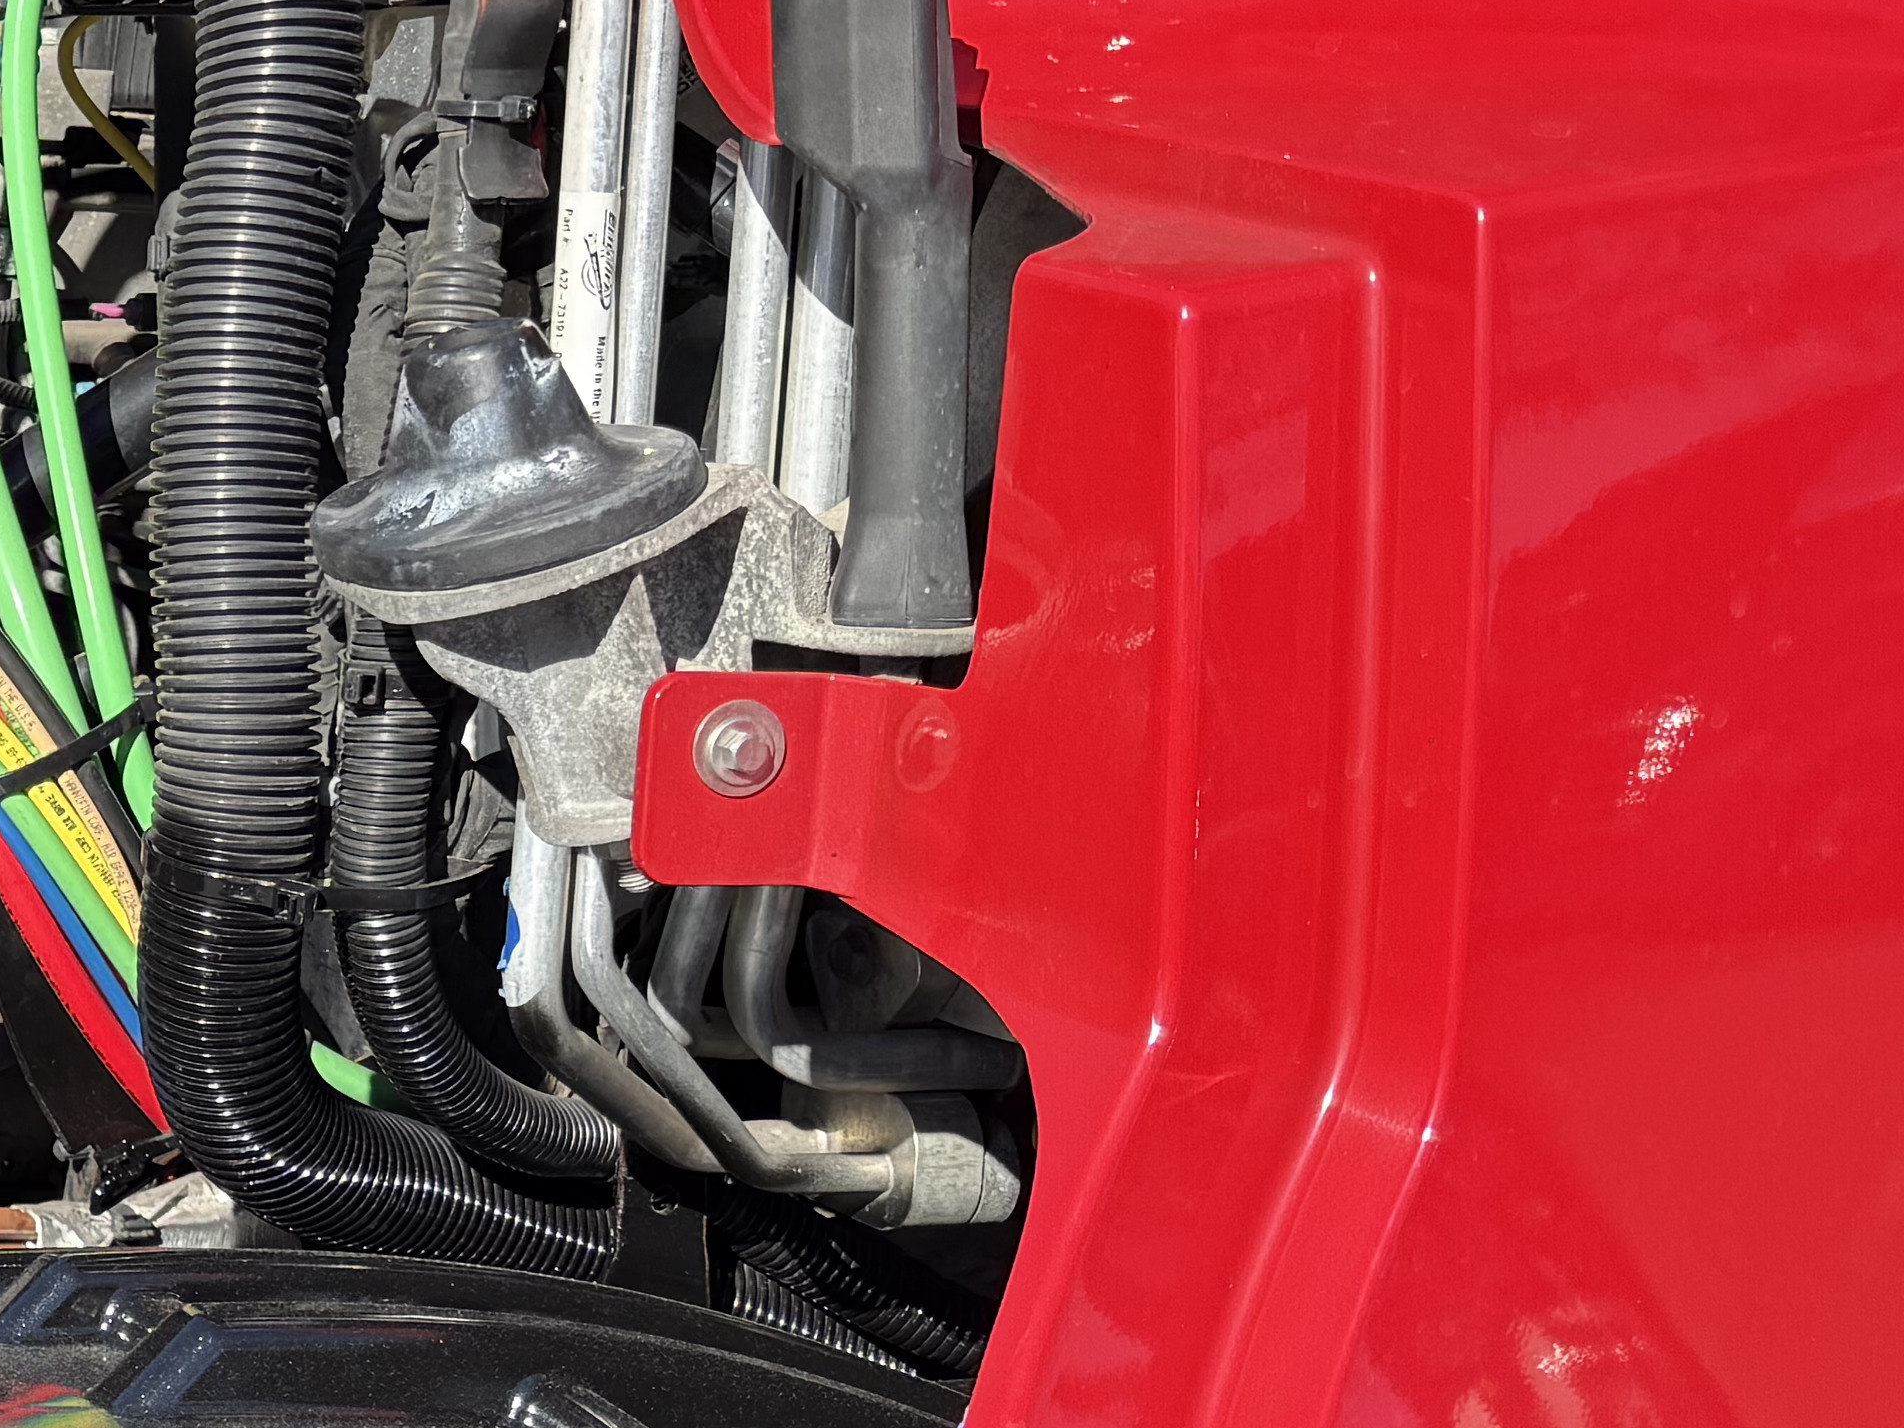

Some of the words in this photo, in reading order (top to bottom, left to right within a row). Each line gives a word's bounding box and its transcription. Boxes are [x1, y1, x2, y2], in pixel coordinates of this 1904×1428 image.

[562, 209, 574, 232] Part
[594, 336, 606, 369] Made
[595, 373, 604, 384] in
[592, 388, 602, 407] the
[2, 687, 20, 706] THE
[100, 841, 118, 860] AIR
